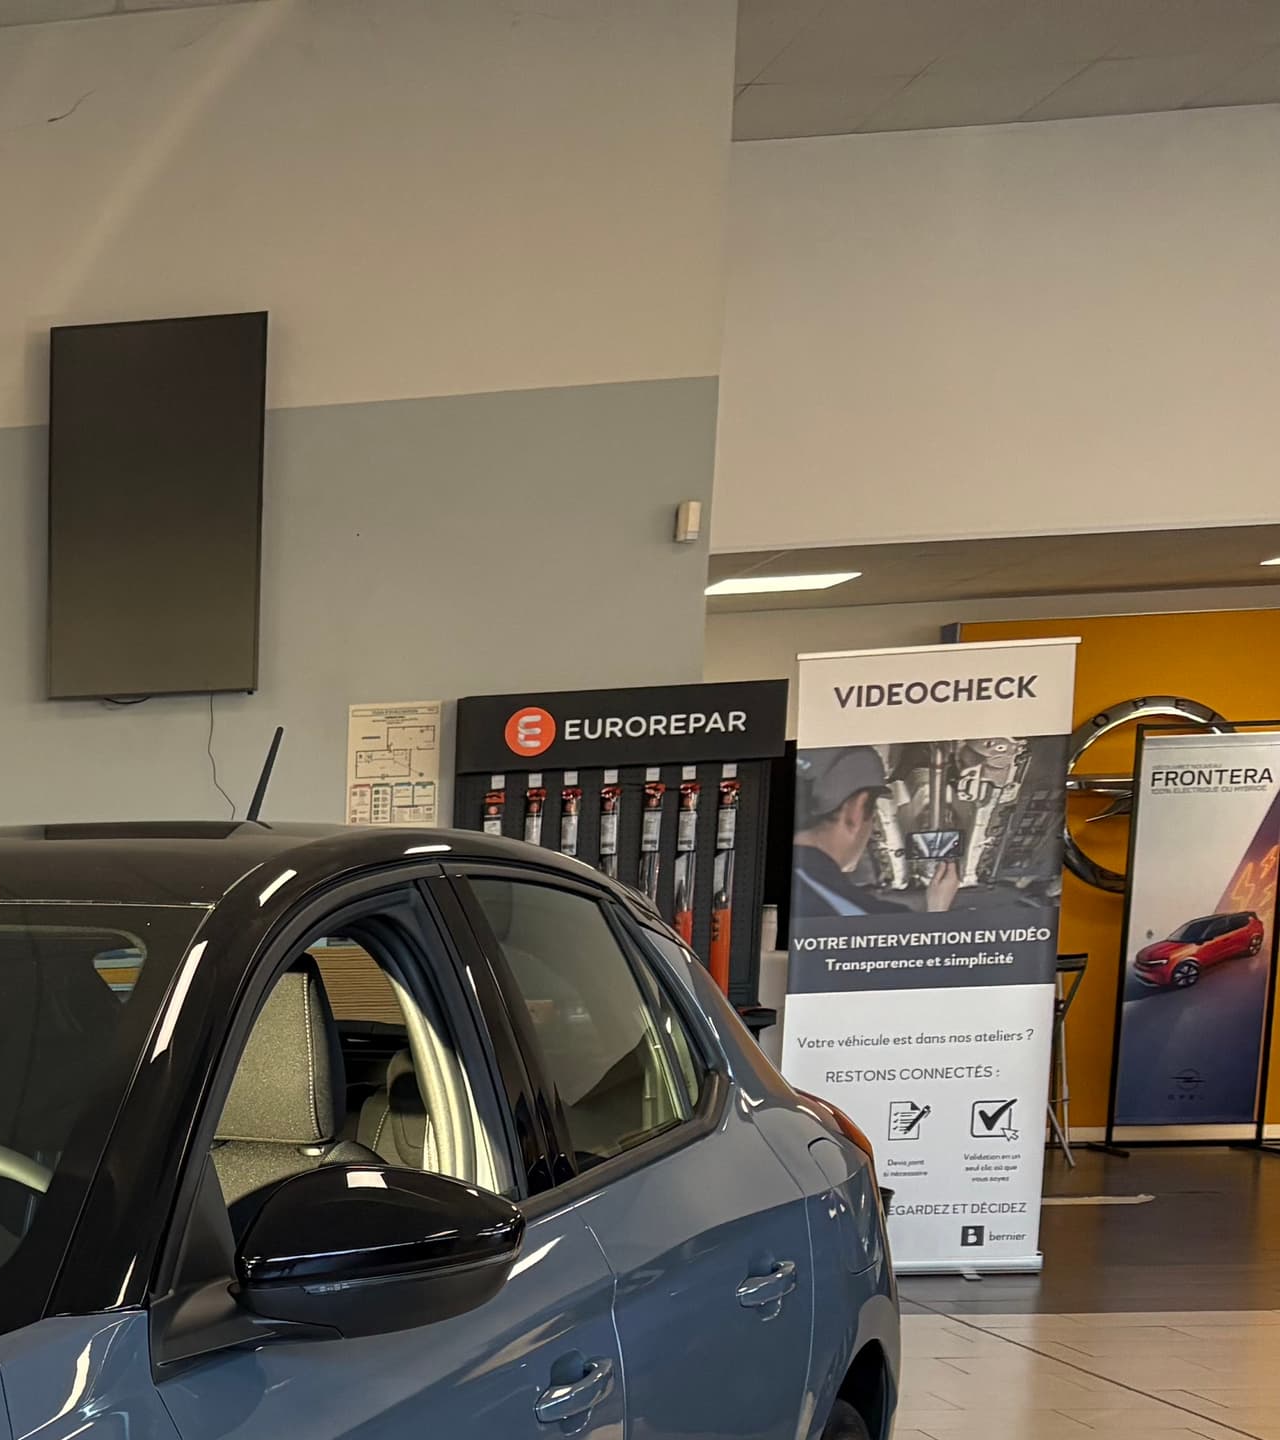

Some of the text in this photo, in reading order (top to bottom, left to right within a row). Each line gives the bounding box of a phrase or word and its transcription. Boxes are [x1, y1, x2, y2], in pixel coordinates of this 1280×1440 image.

[834, 675, 1038, 708] VIDEOCHECK
[564, 711, 747, 741] EUROREPAR
[1151, 767, 1273, 787] FRONTERA
[794, 926, 1051, 951] VOTRE INTERVENTION EN VIDÉO
[825, 952, 1014, 973] Transparence et simplicité
[797, 1028, 1034, 1049] Votre véhicule est dans nos ateliers ?
[825, 1069, 896, 1083] RESTONS
[899, 1064, 993, 1081] CONNECTÉS
[963, 1153, 1000, 1161] Validation
[888, 1201, 1028, 1216] EGARDEZ ET DÉCIDEZ
[989, 1231, 1027, 1241] bernier
